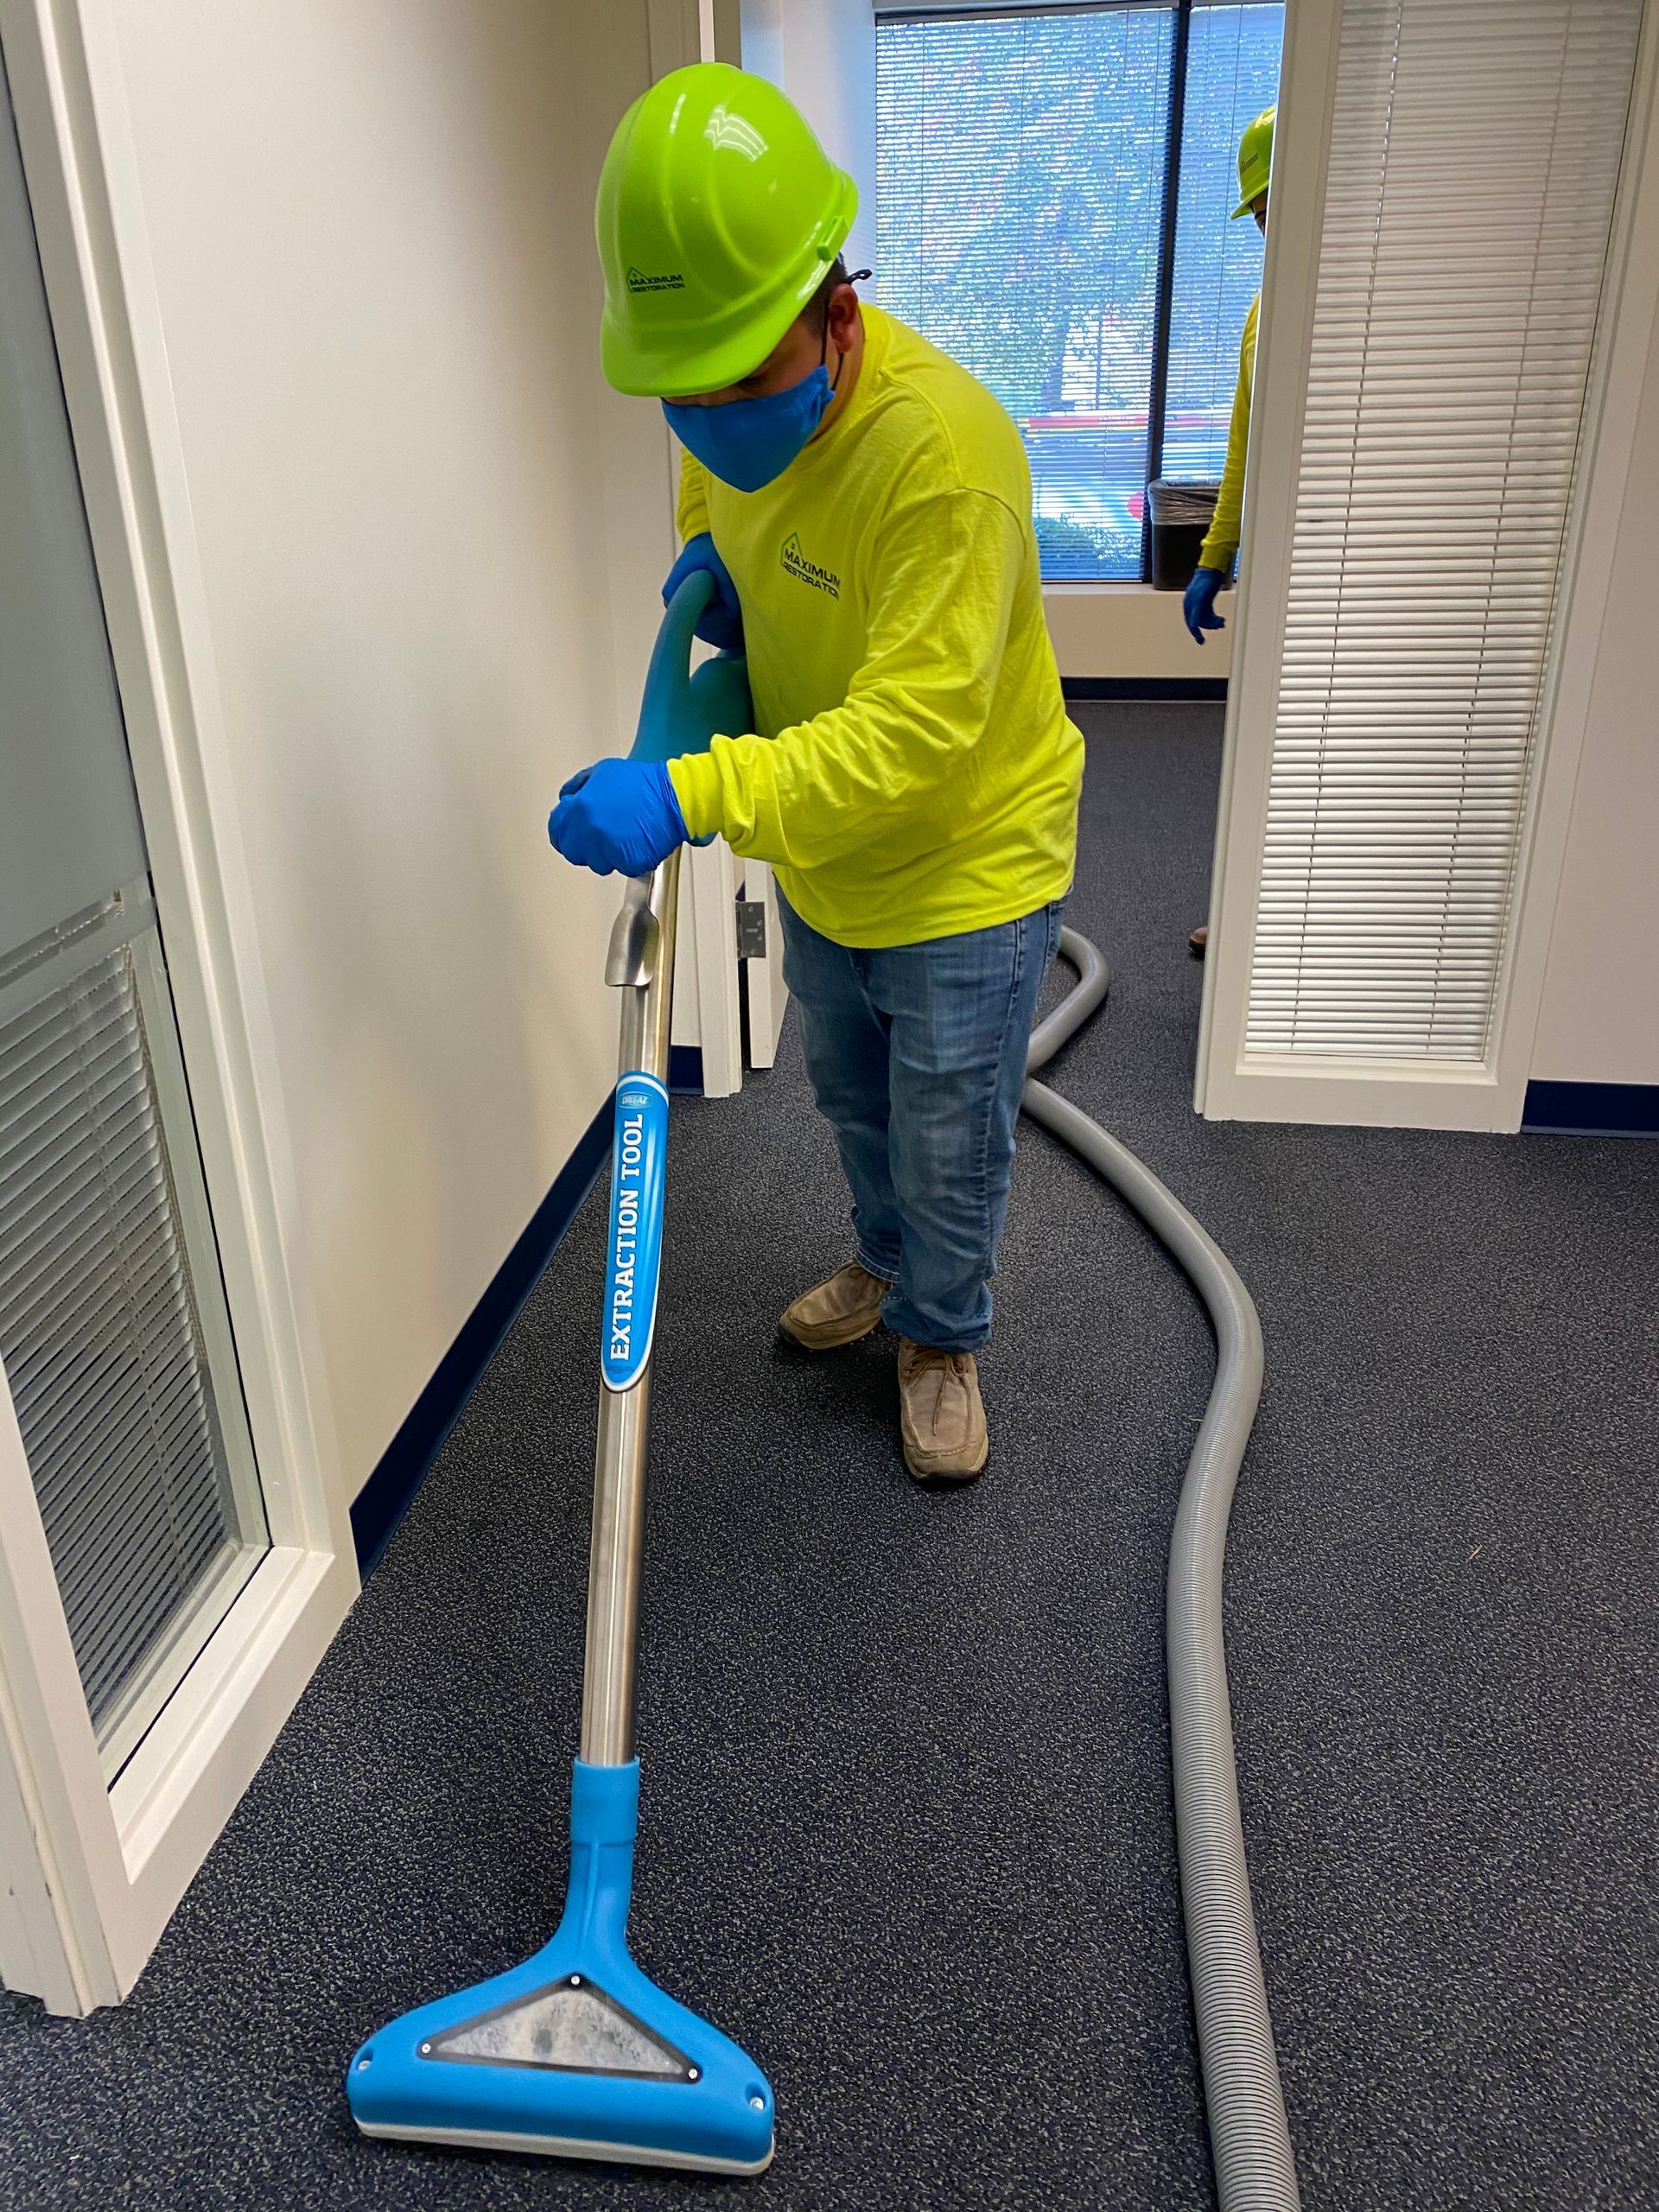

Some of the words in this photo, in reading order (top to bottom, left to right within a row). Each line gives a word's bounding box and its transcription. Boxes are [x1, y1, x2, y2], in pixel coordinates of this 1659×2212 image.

[629, 275, 683, 285] MAXIMUM
[621, 1113, 644, 1181] TOOL
[610, 1189, 639, 1361] EXTRACTION
